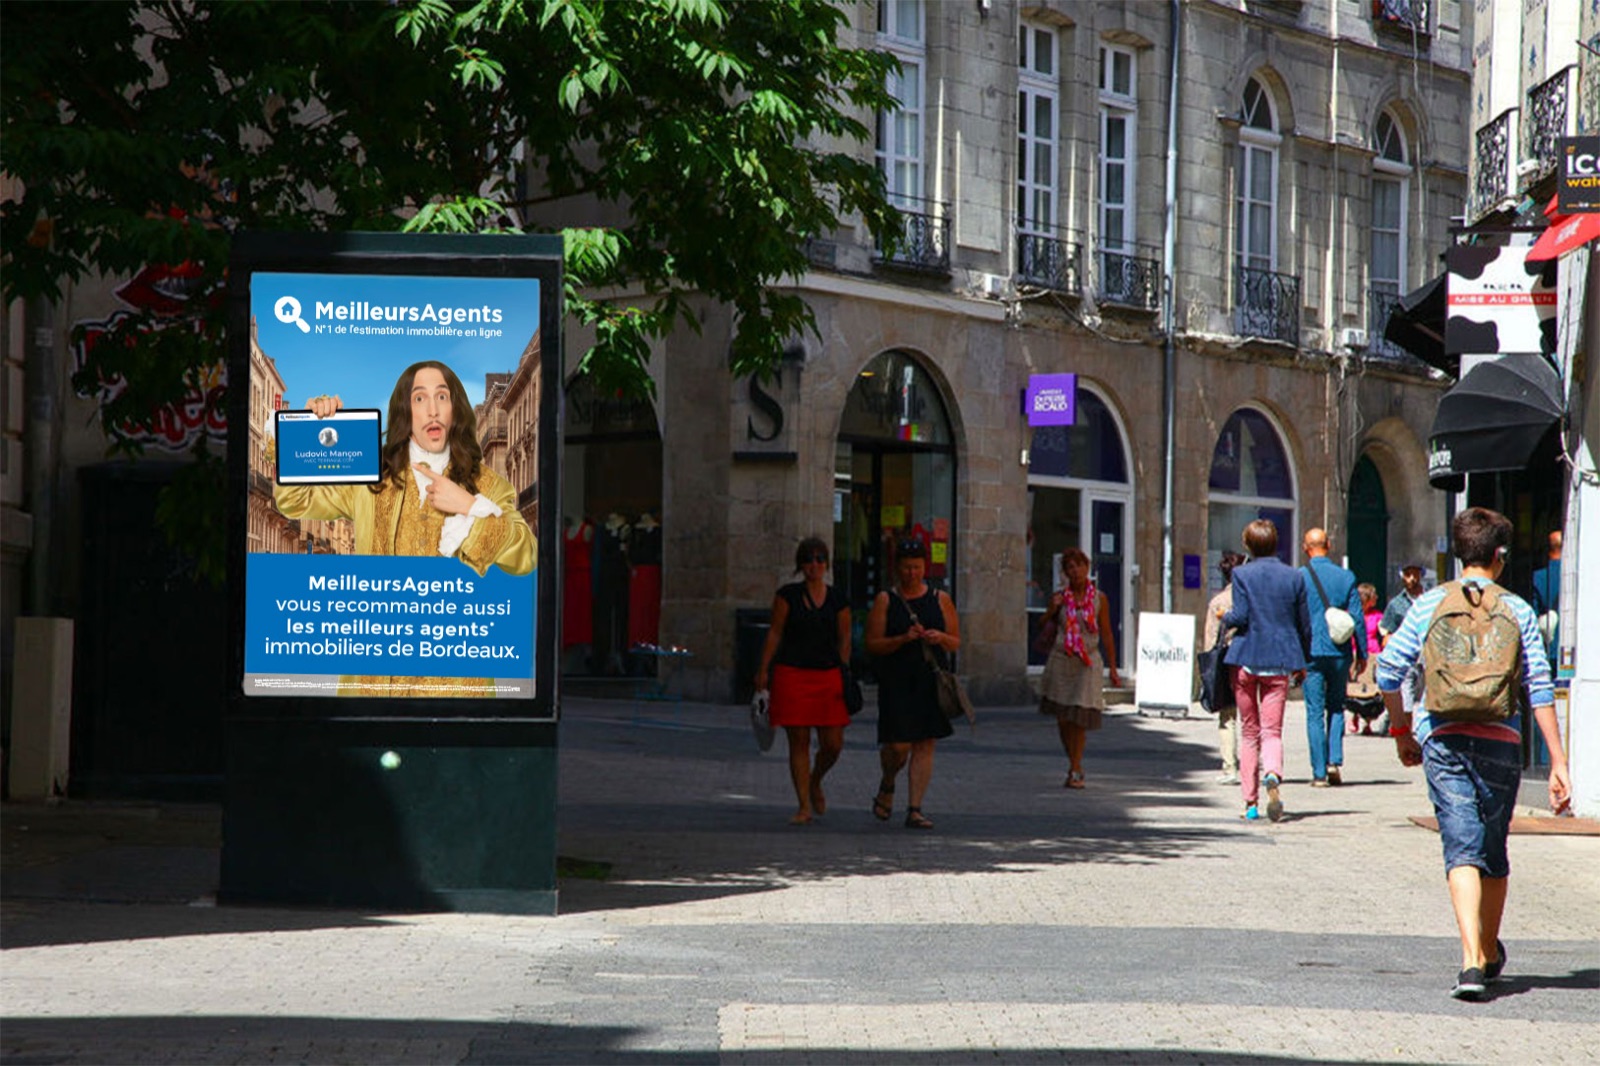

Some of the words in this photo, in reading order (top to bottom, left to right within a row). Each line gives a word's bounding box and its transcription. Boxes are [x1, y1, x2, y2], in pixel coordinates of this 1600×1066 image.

[1489, 295, 1506, 303] AU
[1511, 295, 1552, 303] GREEN
[315, 301, 503, 326] MeilleursAgents
[335, 324, 347, 334] de
[406, 326, 463, 337] immobilière
[465, 328, 477, 337] en
[479, 327, 503, 339] ligne
[747, 366, 784, 442] S
[295, 450, 328, 458] Ludovic
[329, 450, 363, 460] Mançon
[309, 575, 475, 596] MeilleursAgents
[276, 599, 321, 613] vous
[327, 600, 457, 615] recommande
[463, 600, 511, 616] aussi
[287, 618, 315, 634] les
[321, 620, 414, 636] meilleurs
[265, 637, 383, 657] immobiliers
[388, 639, 414, 657] de
[419, 640, 520, 660] Bordeaux.
